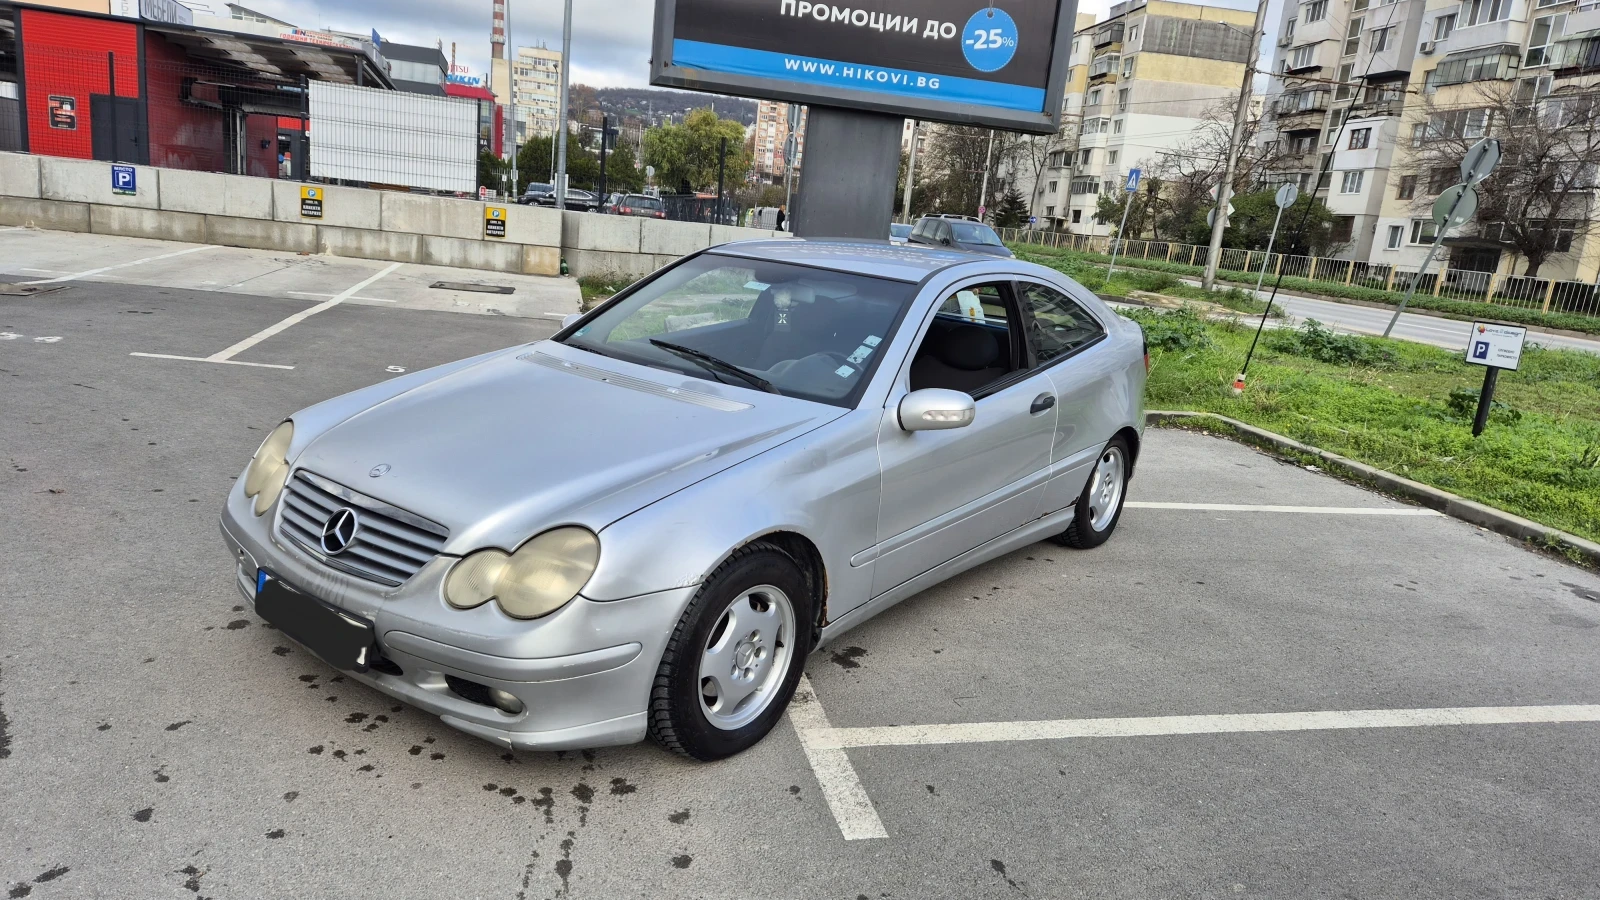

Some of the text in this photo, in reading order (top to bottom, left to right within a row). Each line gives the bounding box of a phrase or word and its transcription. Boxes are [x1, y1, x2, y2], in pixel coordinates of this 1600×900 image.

[780, 0, 957, 40] ПРОМОЦИИ ДО
[965, 28, 1014, 50] -25%
[446, 74, 480, 85] AIKIN
[784, 58, 940, 89] WWW.HIKOVI.BG
[119, 172, 130, 186] P
[1476, 343, 1486, 357] P
